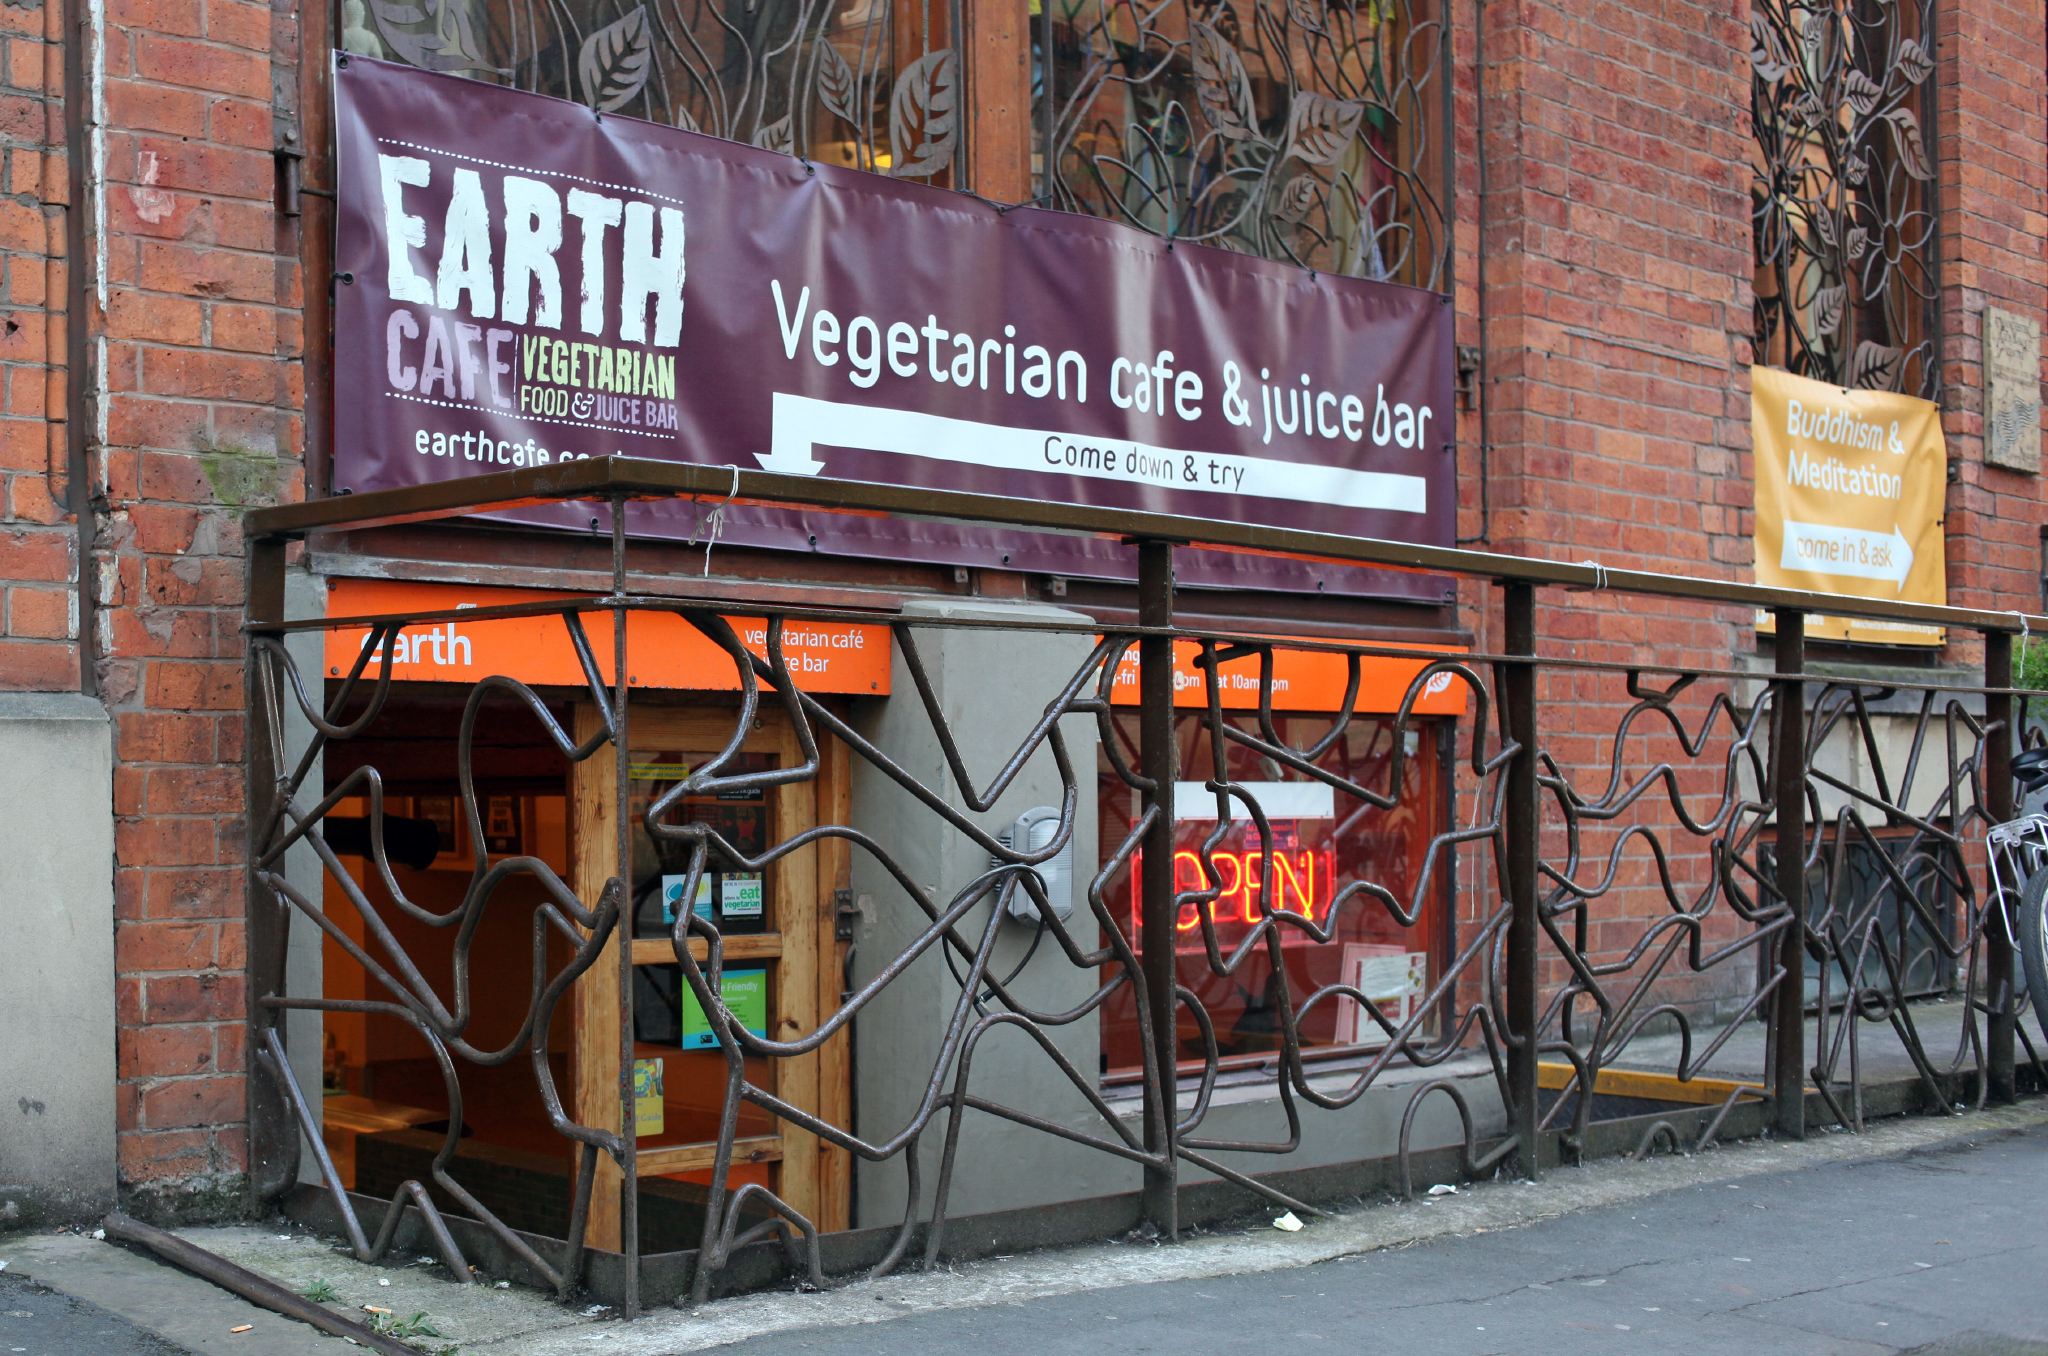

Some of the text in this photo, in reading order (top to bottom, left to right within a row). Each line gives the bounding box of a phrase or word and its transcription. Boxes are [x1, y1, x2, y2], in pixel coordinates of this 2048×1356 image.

[377, 153, 686, 348] EARTH
[386, 309, 514, 409] CAFE
[522, 333, 676, 400] VEGETARIAN
[770, 278, 1433, 450] Vegetarian cafe & juice bar
[521, 385, 679, 431] FOOD & JUICE BAR
[1787, 399, 1905, 455] Buddhism &
[1044, 435, 1245, 493] Come down & try
[1787, 449, 1902, 500] Meditation
[1796, 535, 1894, 568] come in & ask
[361, 622, 472, 666] earth
[745, 627, 864, 650] vetarian café
[803, 652, 829, 672] bar
[724, 899, 760, 910] vegetarian
[740, 886, 760, 899] eat
[1173, 852, 1314, 930] OPEN
[727, 981, 758, 993] Friendly
